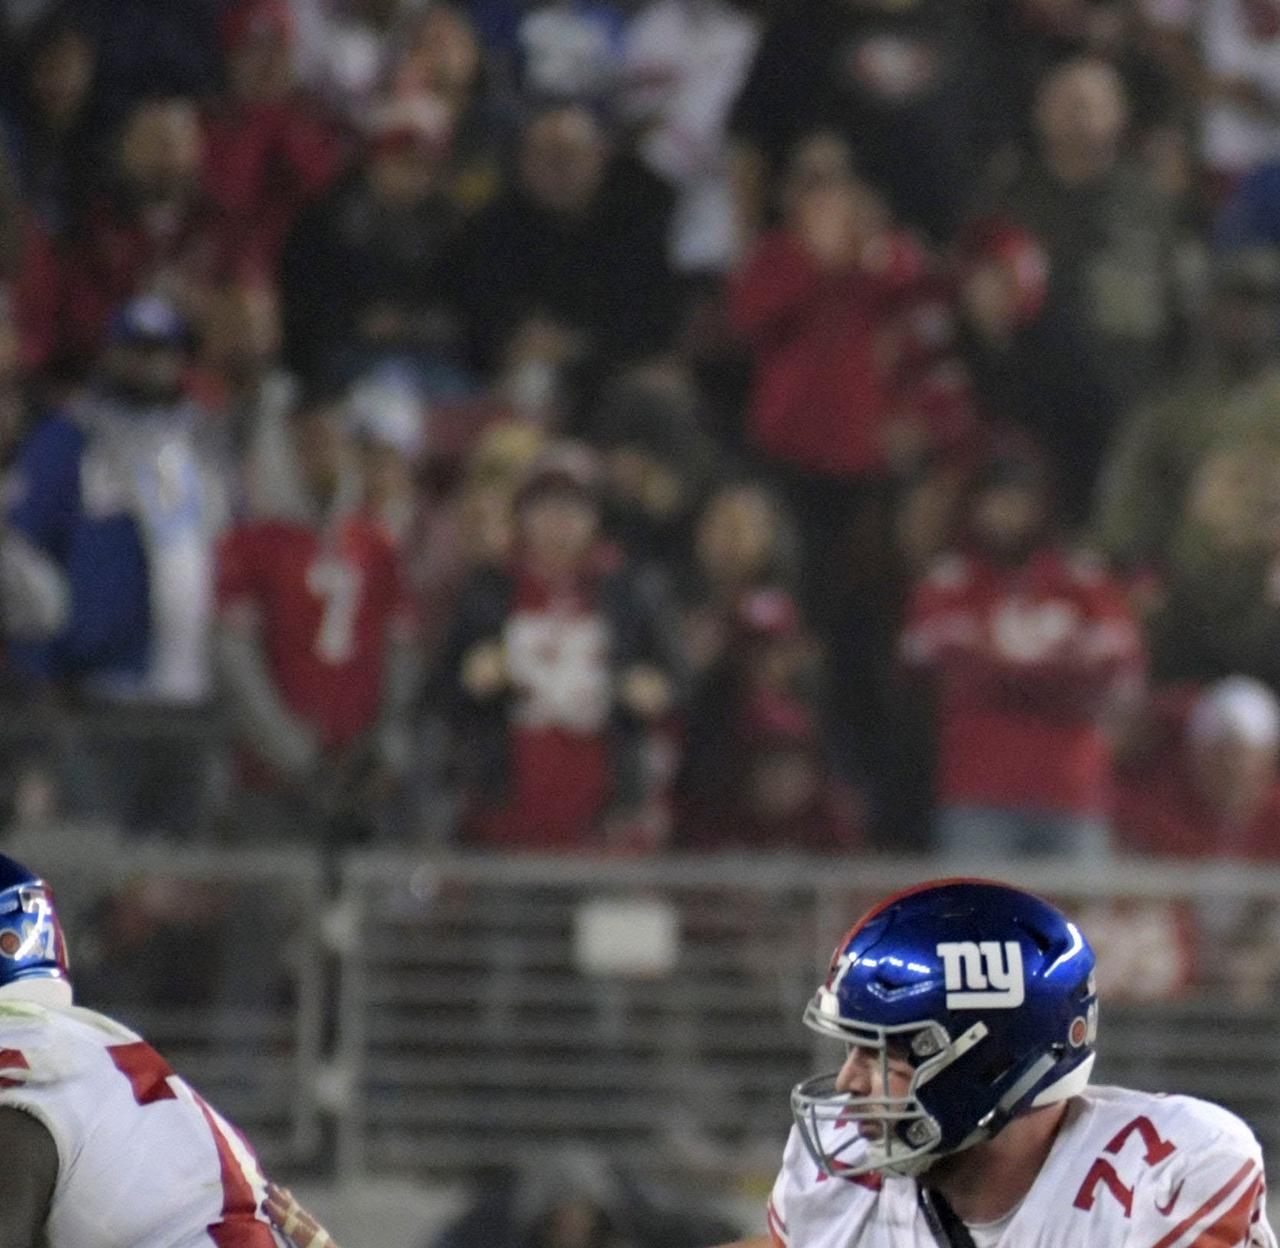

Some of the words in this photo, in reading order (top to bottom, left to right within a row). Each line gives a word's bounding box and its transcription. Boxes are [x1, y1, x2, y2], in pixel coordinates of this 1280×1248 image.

[306, 556, 364, 664] 7
[936, 941, 1024, 1010] ny
[1073, 1115, 1177, 1218] 77
